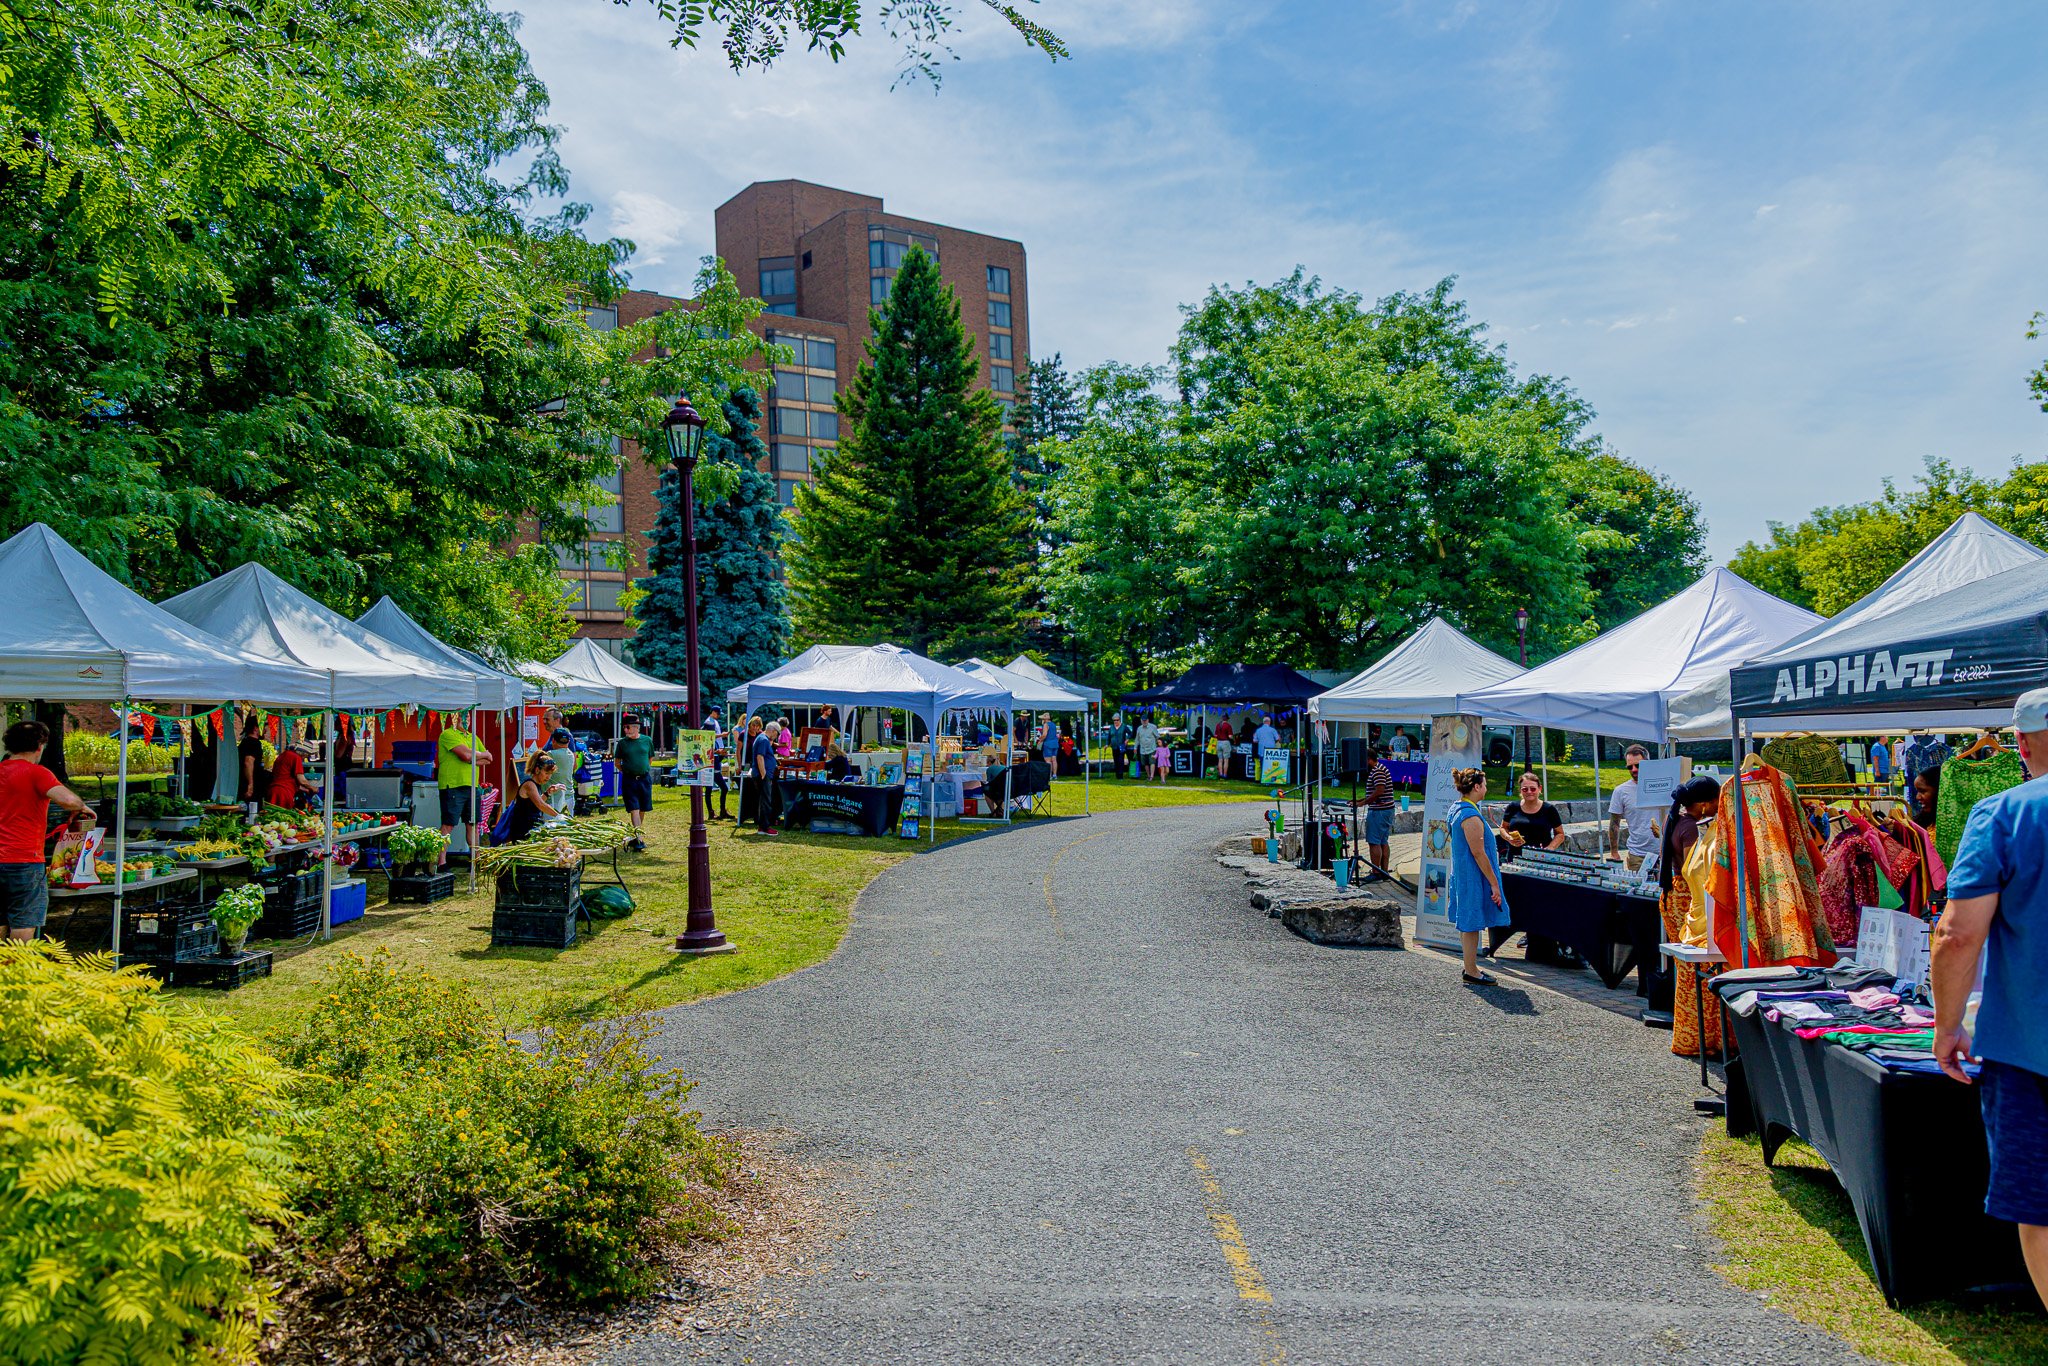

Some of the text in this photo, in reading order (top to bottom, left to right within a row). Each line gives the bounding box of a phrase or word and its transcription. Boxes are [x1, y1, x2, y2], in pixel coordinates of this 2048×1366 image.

[1771, 648, 1992, 704] ALPHAFIT Est 2024
[808, 792, 863, 809] France Légaré
[62, 833, 83, 842] ONIS
